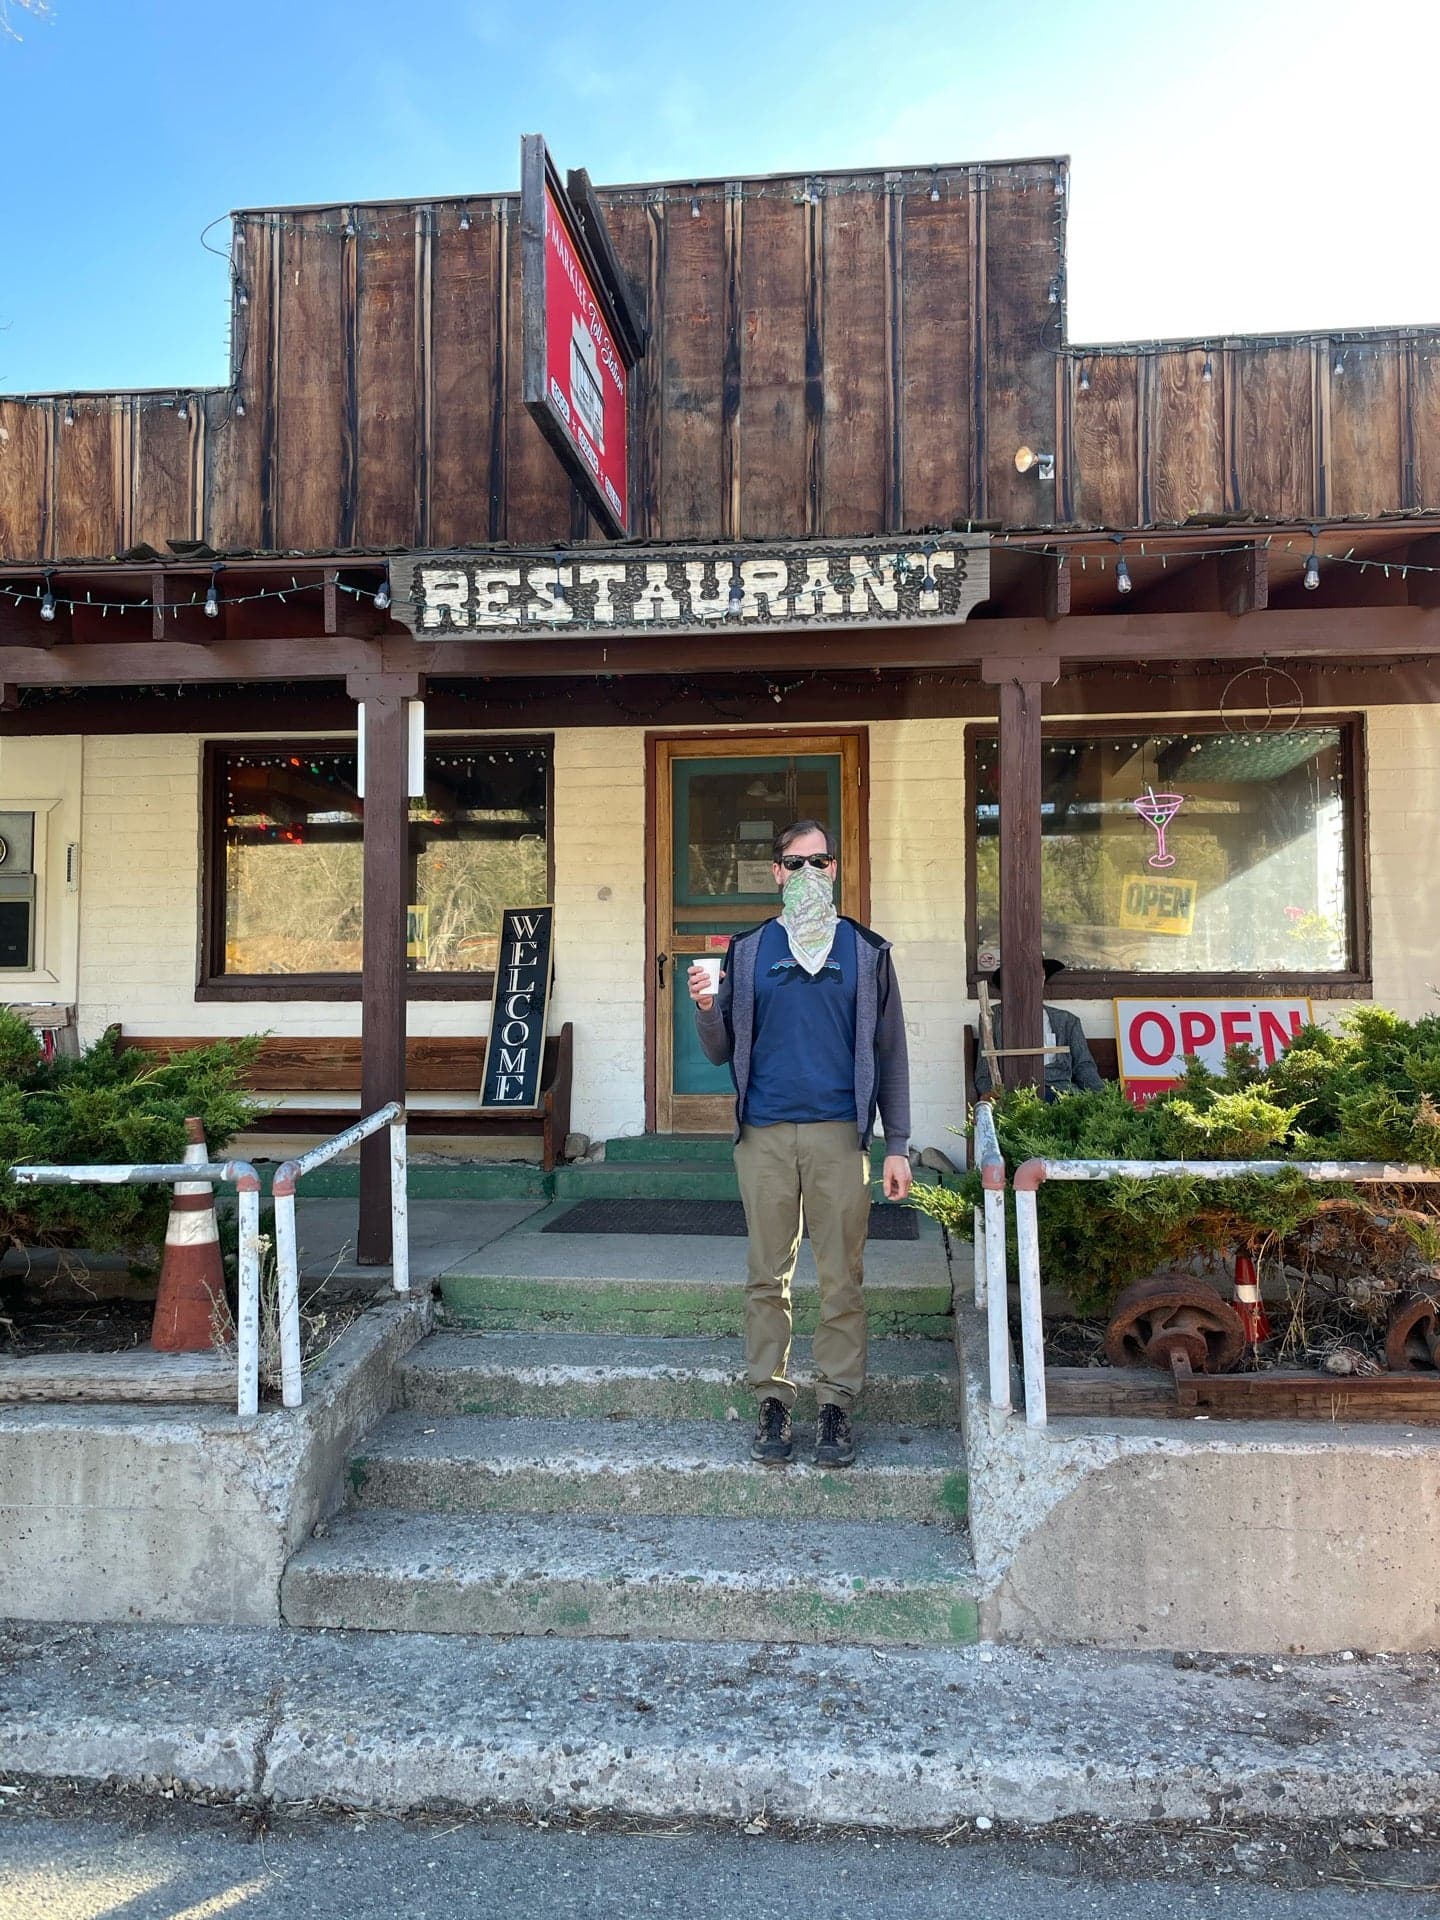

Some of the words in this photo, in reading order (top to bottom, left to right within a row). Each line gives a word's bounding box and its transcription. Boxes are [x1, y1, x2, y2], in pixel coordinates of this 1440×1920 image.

[551, 219, 588, 314] MARKLEE
[588, 301, 603, 346] Toll
[600, 336, 624, 396] Station
[421, 551, 956, 628] RESTAURANT
[1127, 883, 1191, 918] OPEN
[493, 914, 545, 1101] WELCOME
[1128, 1010, 1302, 1067] OPEN
